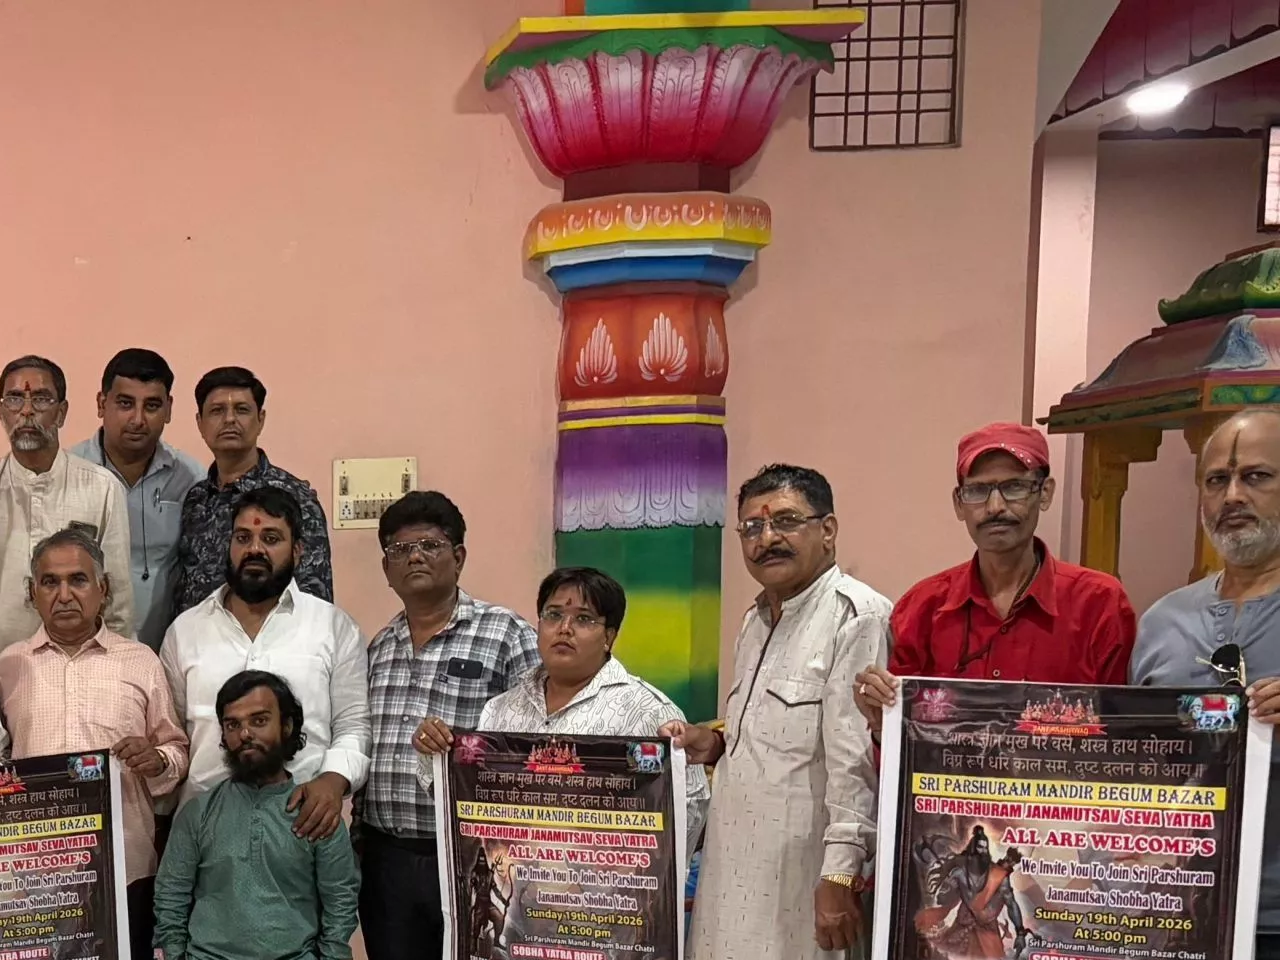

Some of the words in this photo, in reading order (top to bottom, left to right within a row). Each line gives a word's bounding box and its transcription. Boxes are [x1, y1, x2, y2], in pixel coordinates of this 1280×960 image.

[918, 776, 940, 791] SRI
[944, 778, 1031, 796] PARSHURAM
[1035, 783, 1093, 800] MANDIR
[1098, 785, 1152, 802] BEGUM
[1156, 788, 1214, 805] BAZAR
[459, 804, 473, 816] SRI
[475, 805, 534, 819] PARSHURAM
[536, 809, 573, 822] MANDIR
[577, 811, 611, 824] BEGUM
[616, 813, 655, 827] BAZAR
[914, 797, 939, 813] SRI
[939, 799, 1023, 818] PARSHURAM
[1025, 803, 1120, 823] JANAMUTSAV
[1123, 808, 1162, 826] SEVA
[1165, 810, 1213, 829] YATRA
[21, 821, 57, 834] BEGUM
[59, 816, 95, 830] BAZAR
[1001, 828, 1039, 845] ALL
[1044, 830, 1086, 848] ARE
[1090, 832, 1216, 856] WELCOME'S
[508, 845, 532, 859] ALL
[536, 847, 563, 862] ARE
[567, 849, 649, 868] WELCOME'S
[11, 914, 31, 924] 19th
[34, 910, 57, 922] April
[60, 908, 83, 918] 2026
[1034, 908, 1083, 923] Sunday
[1087, 911, 1116, 924] 19th
[1120, 914, 1153, 930] April
[1158, 917, 1190, 929] 2026
